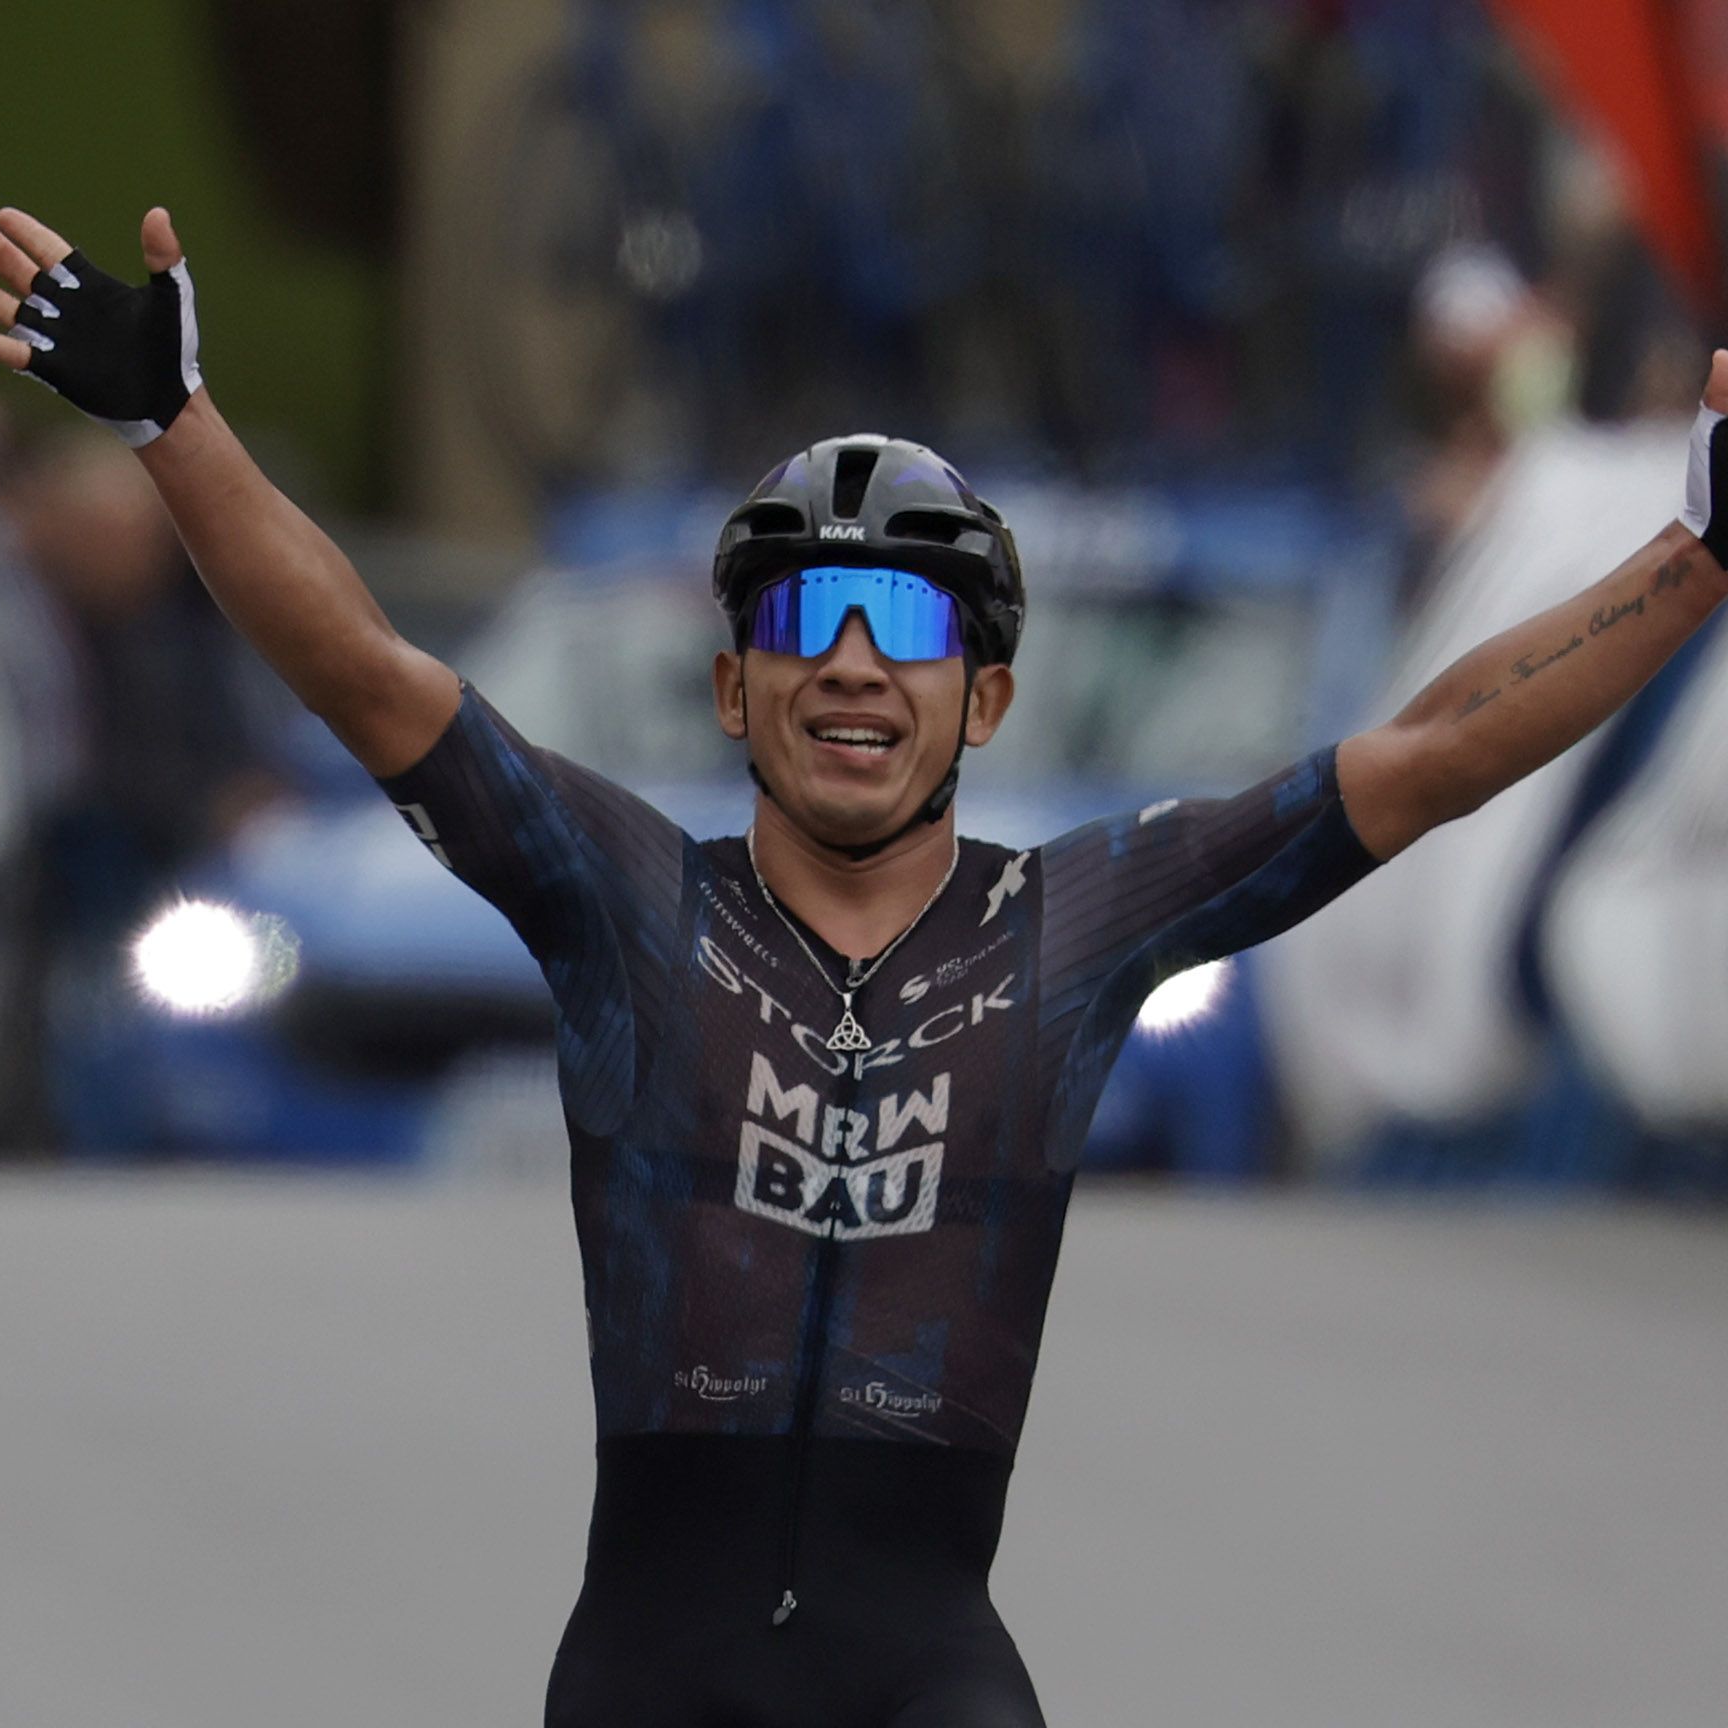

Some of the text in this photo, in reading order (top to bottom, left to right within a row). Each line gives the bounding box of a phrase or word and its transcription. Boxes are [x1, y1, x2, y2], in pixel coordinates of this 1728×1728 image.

[819, 524, 865, 541] KASK
[696, 935, 1016, 1081] STORCK
[745, 1050, 952, 1159] MRW
[751, 1149, 925, 1231] BAU
